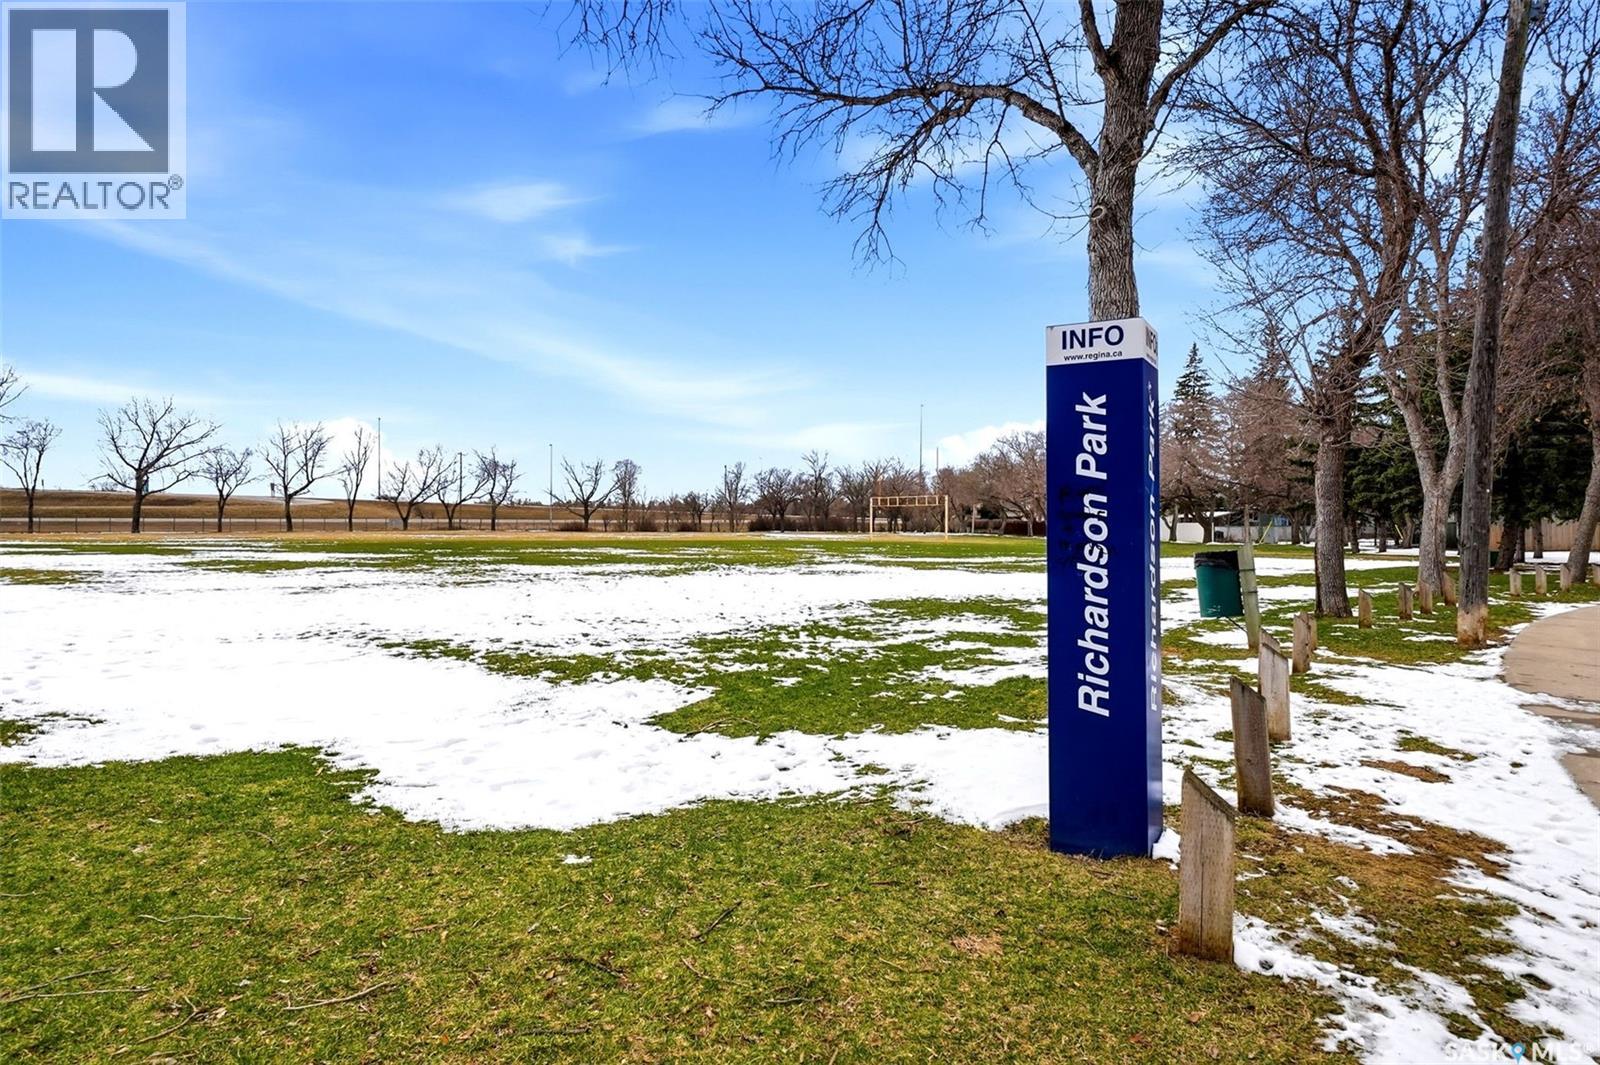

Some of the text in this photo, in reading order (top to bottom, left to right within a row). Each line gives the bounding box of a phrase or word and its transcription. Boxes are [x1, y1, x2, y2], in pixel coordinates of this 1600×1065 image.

[1062, 325, 1124, 350] INFO
[1064, 350, 1123, 361] www.regina.ca
[1075, 391, 1110, 717] Richardson Park
[1147, 393, 1157, 711] Richardson Park
